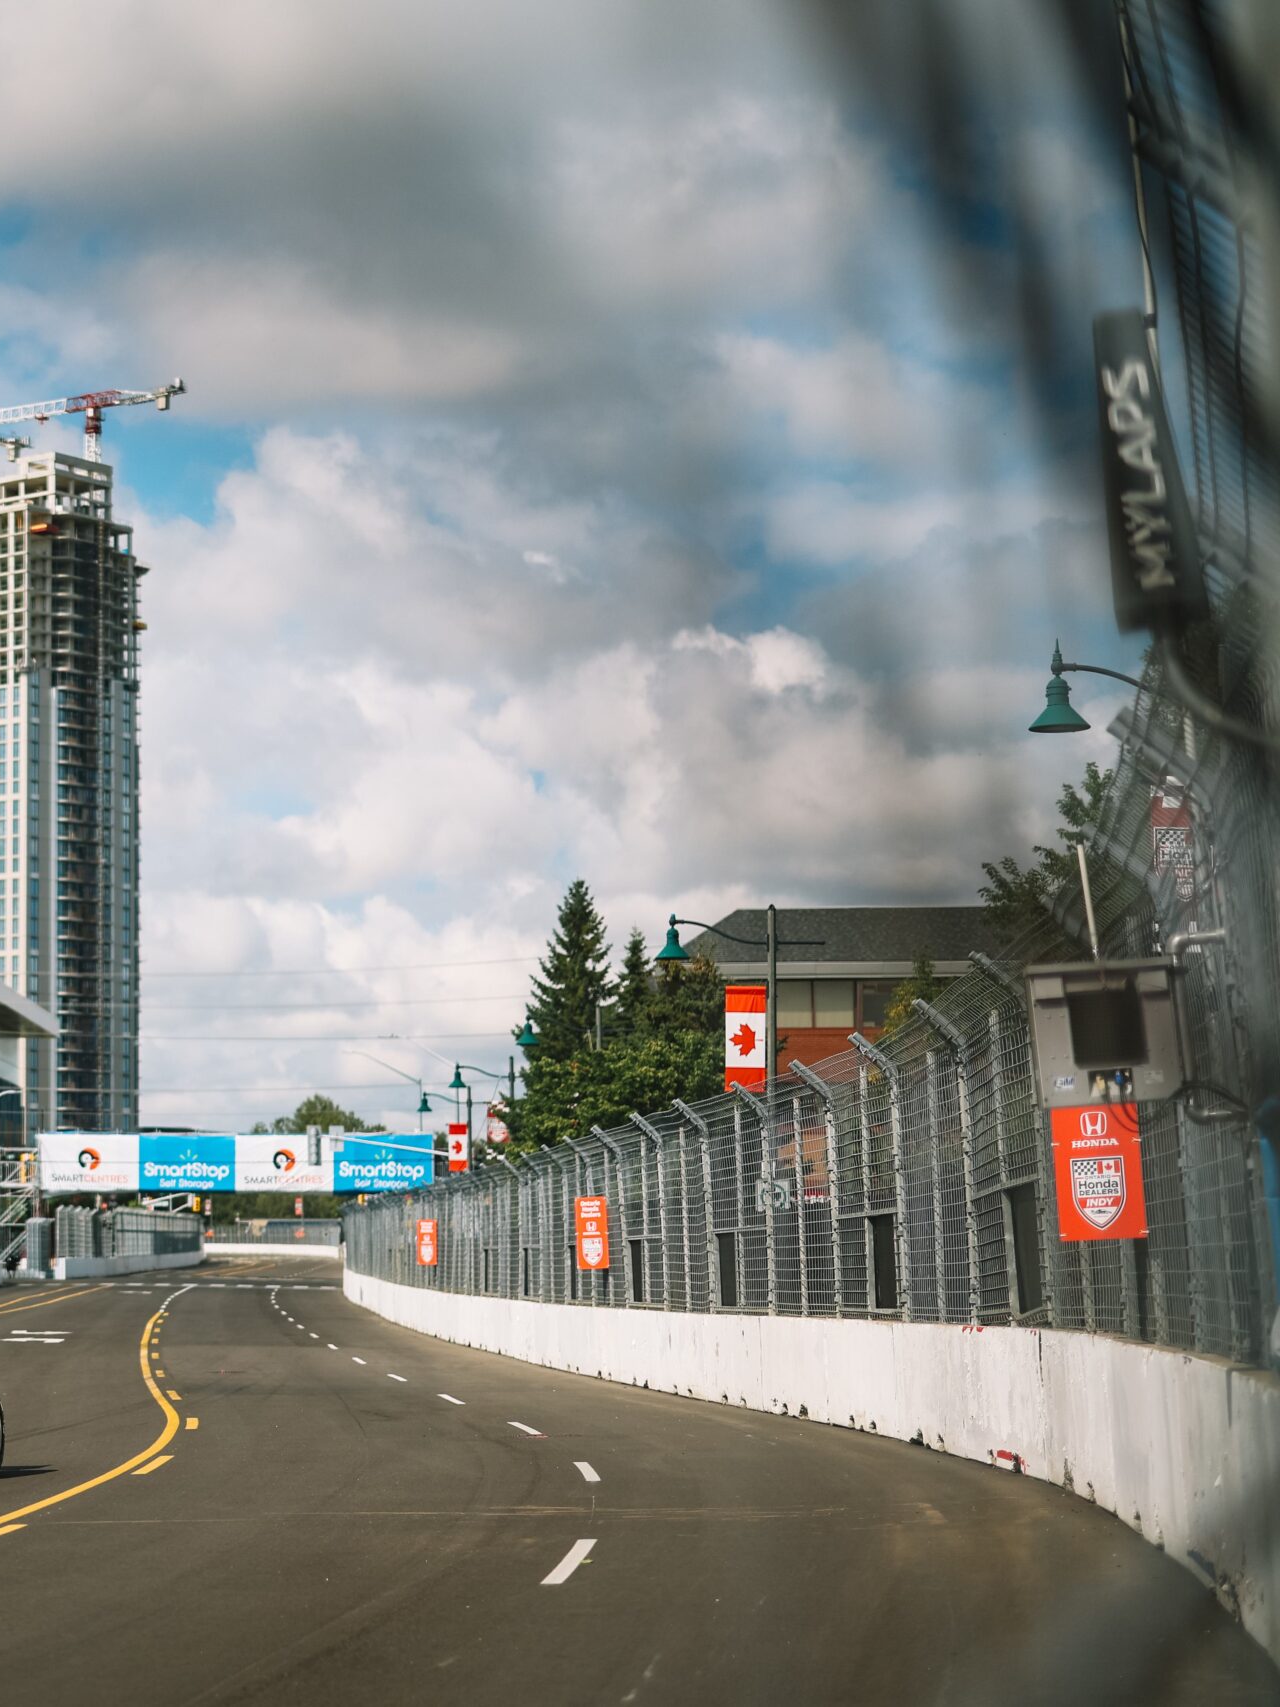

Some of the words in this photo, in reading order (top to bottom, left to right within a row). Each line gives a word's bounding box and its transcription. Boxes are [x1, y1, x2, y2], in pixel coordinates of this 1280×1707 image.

[1102, 362, 1175, 590] MYLAPS
[1071, 1138, 1119, 1149] HONDA
[144, 1161, 229, 1181] SmartStop
[339, 1161, 424, 1181] SmartStop
[159, 1178, 177, 1188] Self
[178, 1178, 215, 1190] Storage
[1078, 1180, 1118, 1189] Honda
[1079, 1188, 1119, 1196] DEALERS
[1086, 1197, 1114, 1208] INDY
